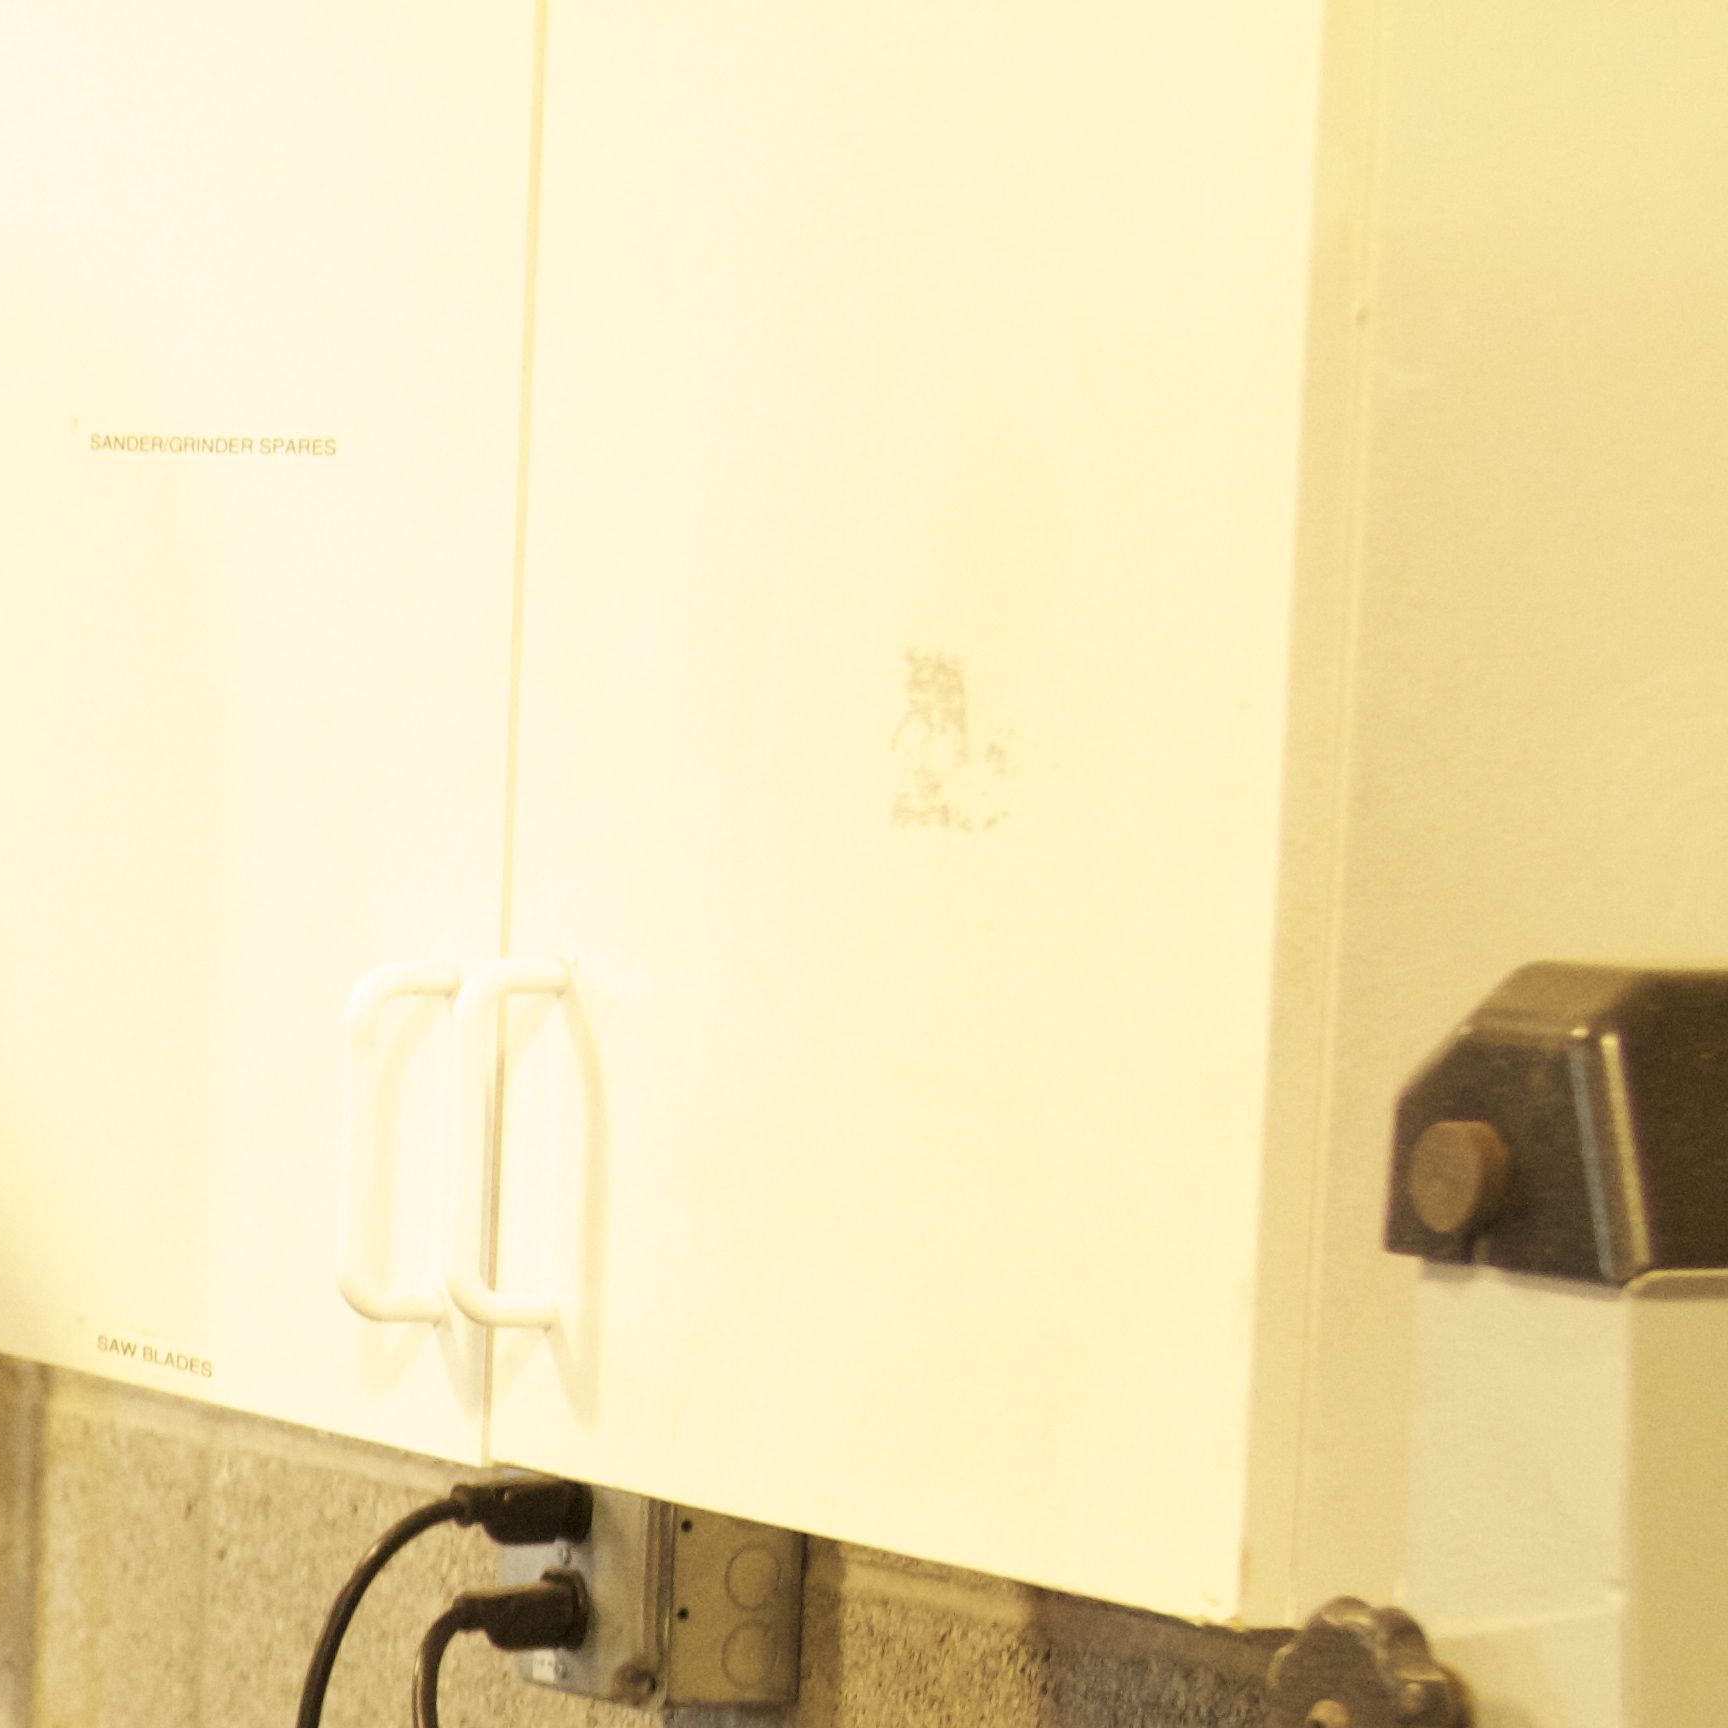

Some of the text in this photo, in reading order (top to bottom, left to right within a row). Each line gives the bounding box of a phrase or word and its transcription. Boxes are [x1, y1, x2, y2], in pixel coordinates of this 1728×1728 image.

[90, 433, 337, 456] SANDER/GRINDER SPARES
[97, 1335, 213, 1378] SAW BLADES
